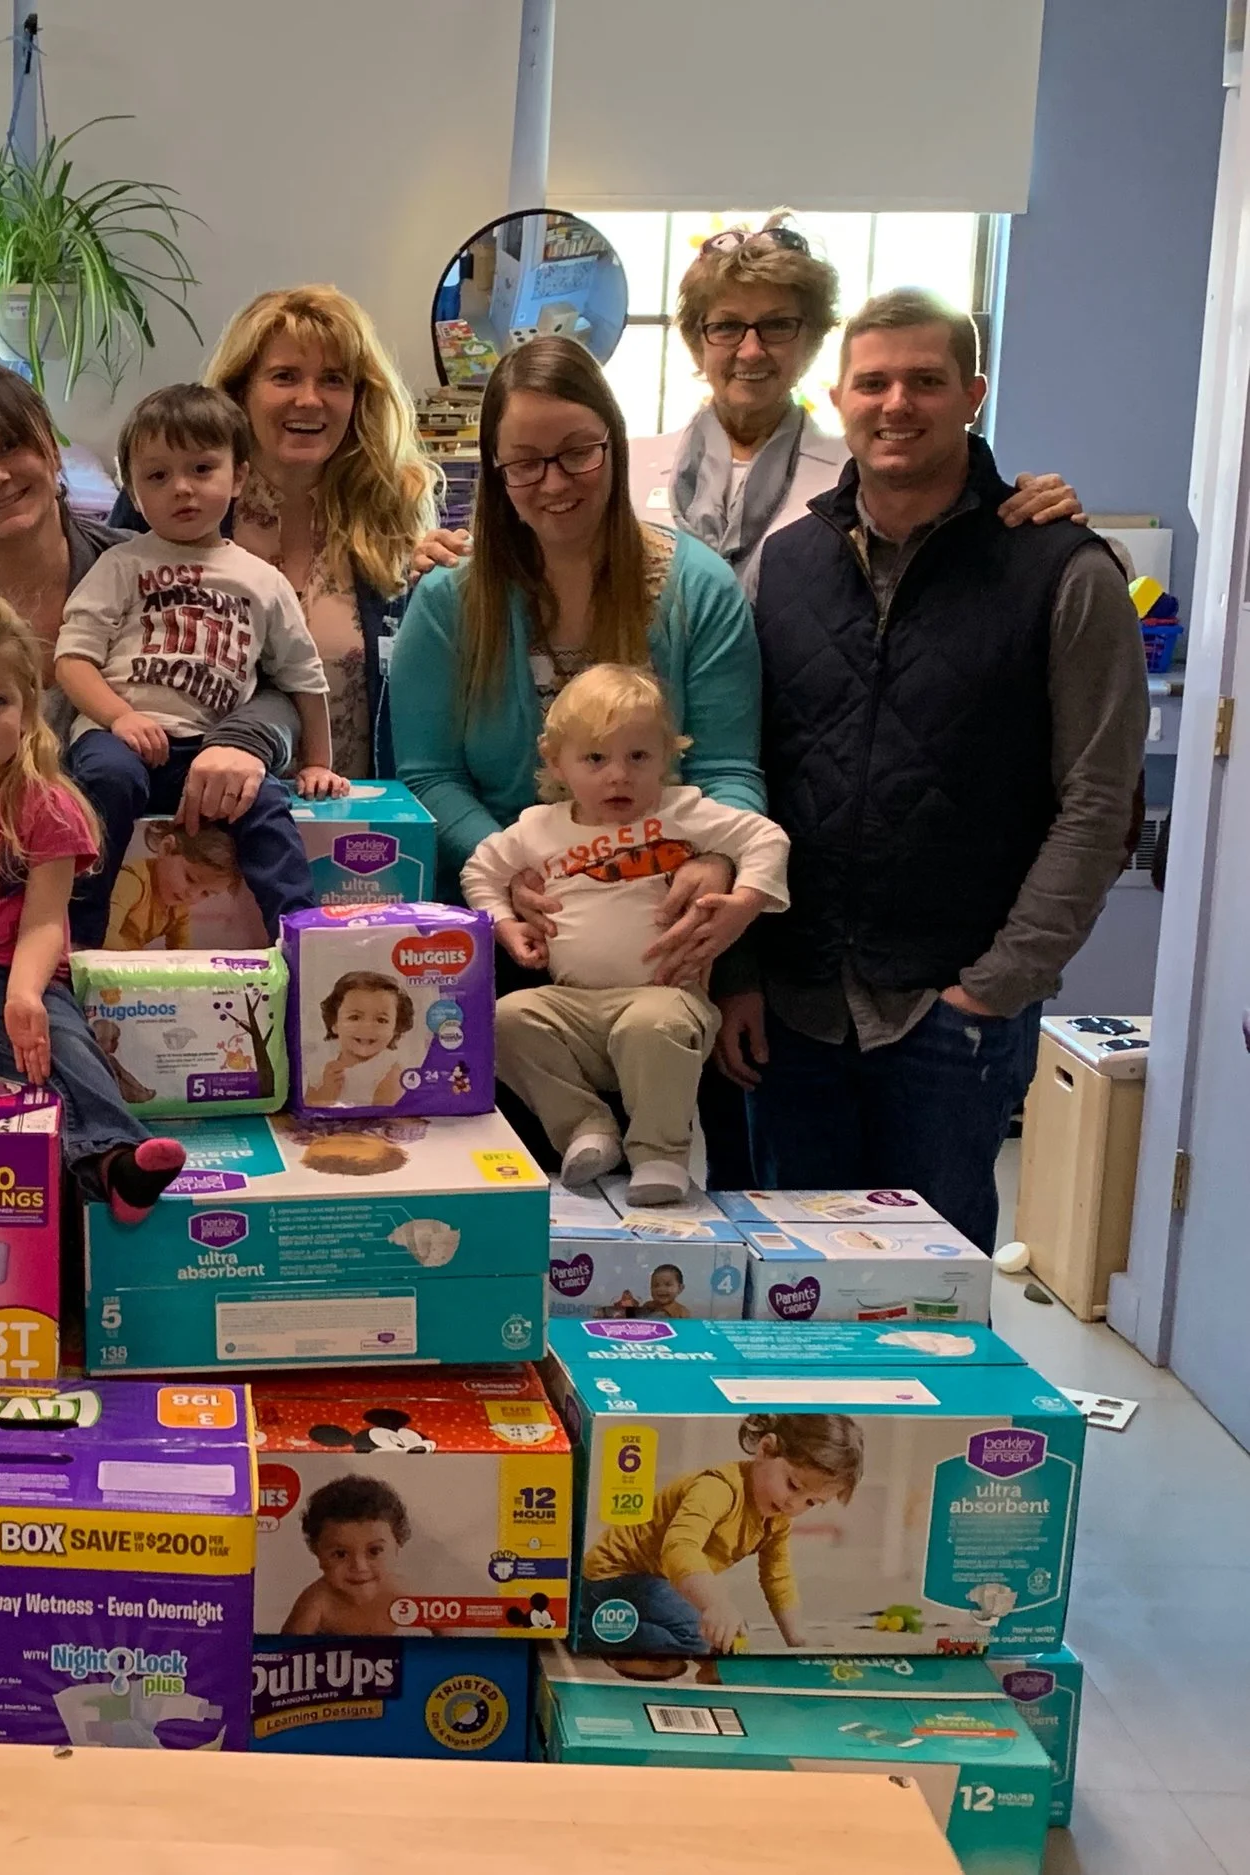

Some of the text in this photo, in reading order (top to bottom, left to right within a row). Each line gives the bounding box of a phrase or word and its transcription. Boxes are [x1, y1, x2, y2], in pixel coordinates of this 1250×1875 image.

[138, 563, 204, 597] MOST
[140, 606, 252, 682] LITTLE
[345, 839, 390, 851] berkley
[344, 851, 388, 864] jensen
[341, 879, 380, 892] ultra
[320, 891, 404, 904] absorbent
[400, 949, 467, 966] HUGGIES
[408, 975, 458, 986] movers
[99, 1001, 177, 1021] tugaboos
[424, 1071, 439, 1081] 24
[193, 1078, 206, 1098] 5
[212, 1088, 225, 1097] 24
[200, 1216, 239, 1229] berkley
[197, 1251, 238, 1265] ultra
[177, 1263, 265, 1280] absorbent
[551, 1262, 591, 1281] Parent's
[558, 1279, 586, 1290] CHOICE
[717, 1274, 734, 1294] 4
[774, 1286, 817, 1306] Parent's
[101, 1304, 122, 1329] 5
[783, 1301, 812, 1316] CHOICE
[100, 1345, 128, 1361] 138
[586, 1349, 717, 1361] absorbent
[610, 1342, 672, 1353] ultra
[596, 1380, 621, 1393] 6
[171, 1393, 223, 1407] 198
[198, 1412, 215, 1426] 3
[621, 1435, 642, 1443] SIZE
[983, 1435, 1036, 1451] berkley
[617, 1444, 642, 1473] 6
[981, 1450, 1031, 1465] jensen
[519, 1486, 556, 1509] 12
[976, 1481, 1022, 1499] ultra
[610, 1493, 644, 1509] 120
[949, 1497, 1050, 1514] absorbent
[512, 1510, 557, 1519] HOUR
[0, 1522, 68, 1556] BOX
[70, 1528, 131, 1553] SAVE
[134, 1531, 145, 1542] UP
[146, 1532, 208, 1557] $200
[208, 1535, 224, 1545] PER
[26, 1592, 94, 1616] Wetness
[107, 1595, 144, 1618] Even
[147, 1597, 225, 1627] Overnight
[398, 1601, 410, 1615] 3
[419, 1600, 462, 1619] 100
[22, 1649, 49, 1662] WITH
[144, 1673, 184, 1698] plus
[435, 1679, 499, 1702] TRUSTED
[271, 1690, 340, 1709] TRAINING PANTS
[266, 1704, 374, 1731] Learning Designs
[959, 1785, 1035, 1812] 12 HOURS
